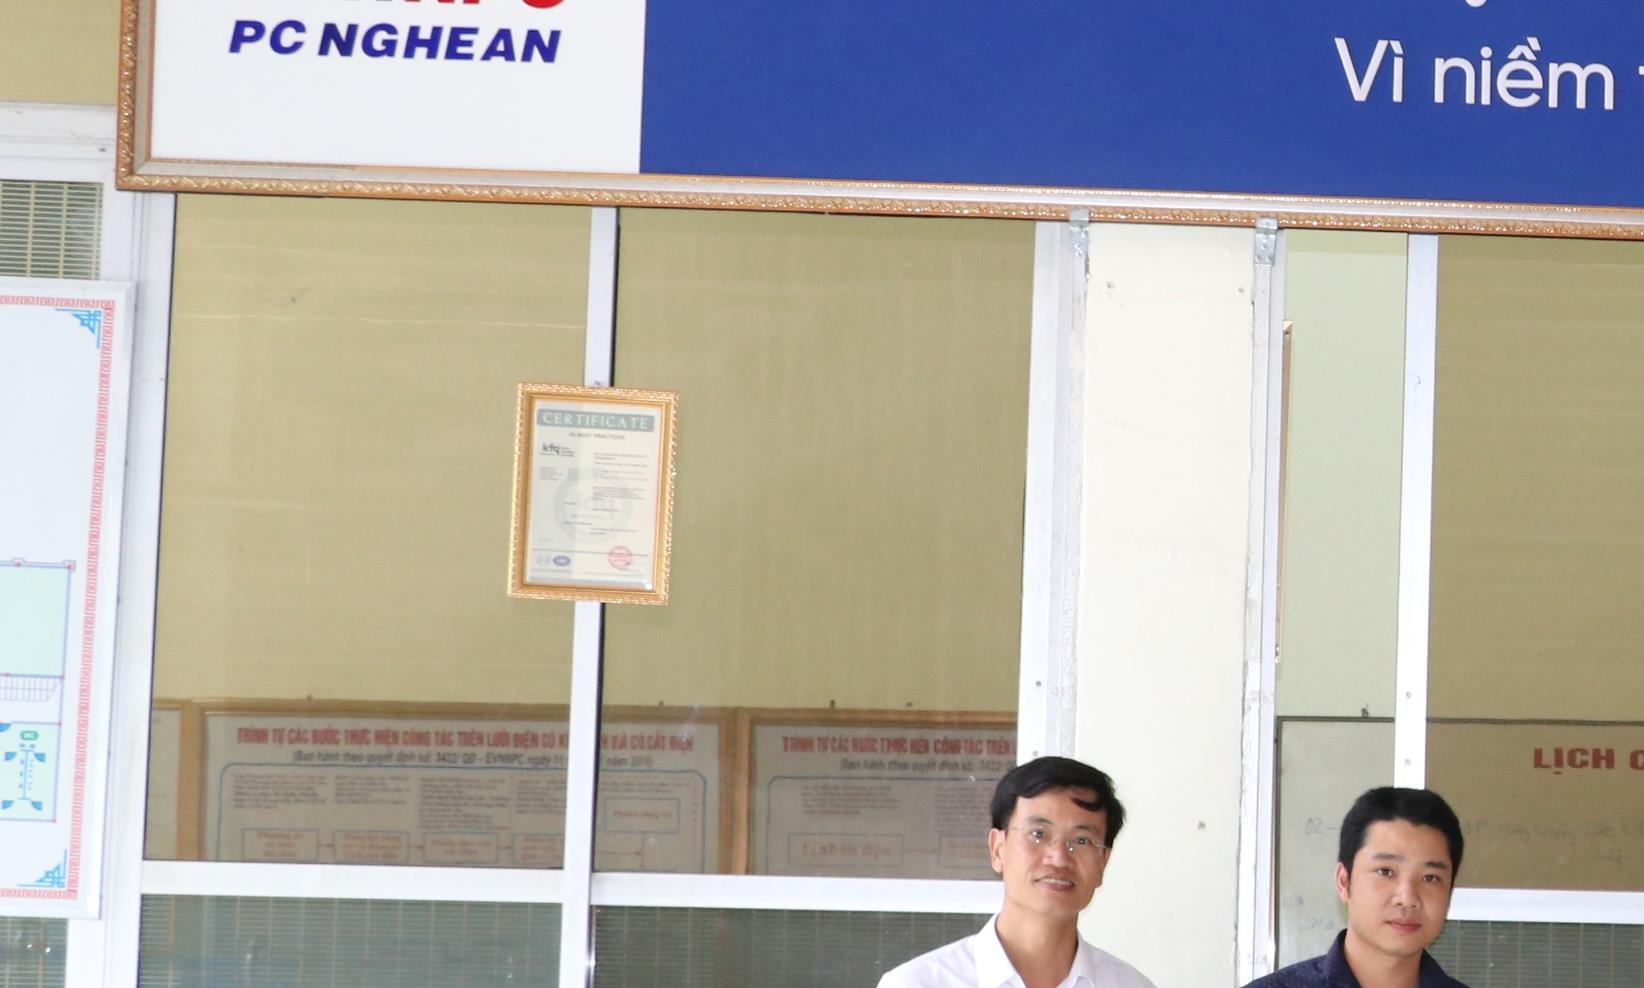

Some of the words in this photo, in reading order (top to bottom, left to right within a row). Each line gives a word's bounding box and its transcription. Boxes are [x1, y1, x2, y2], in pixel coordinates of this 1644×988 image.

[229, 19, 306, 55] PC
[317, 22, 562, 64] NGHEAN
[1334, 37, 1404, 103] Vì
[1434, 37, 1614, 110] niềm
[542, 411, 649, 430] CERTIFICATE
[1532, 747, 1616, 775] LỊCH
